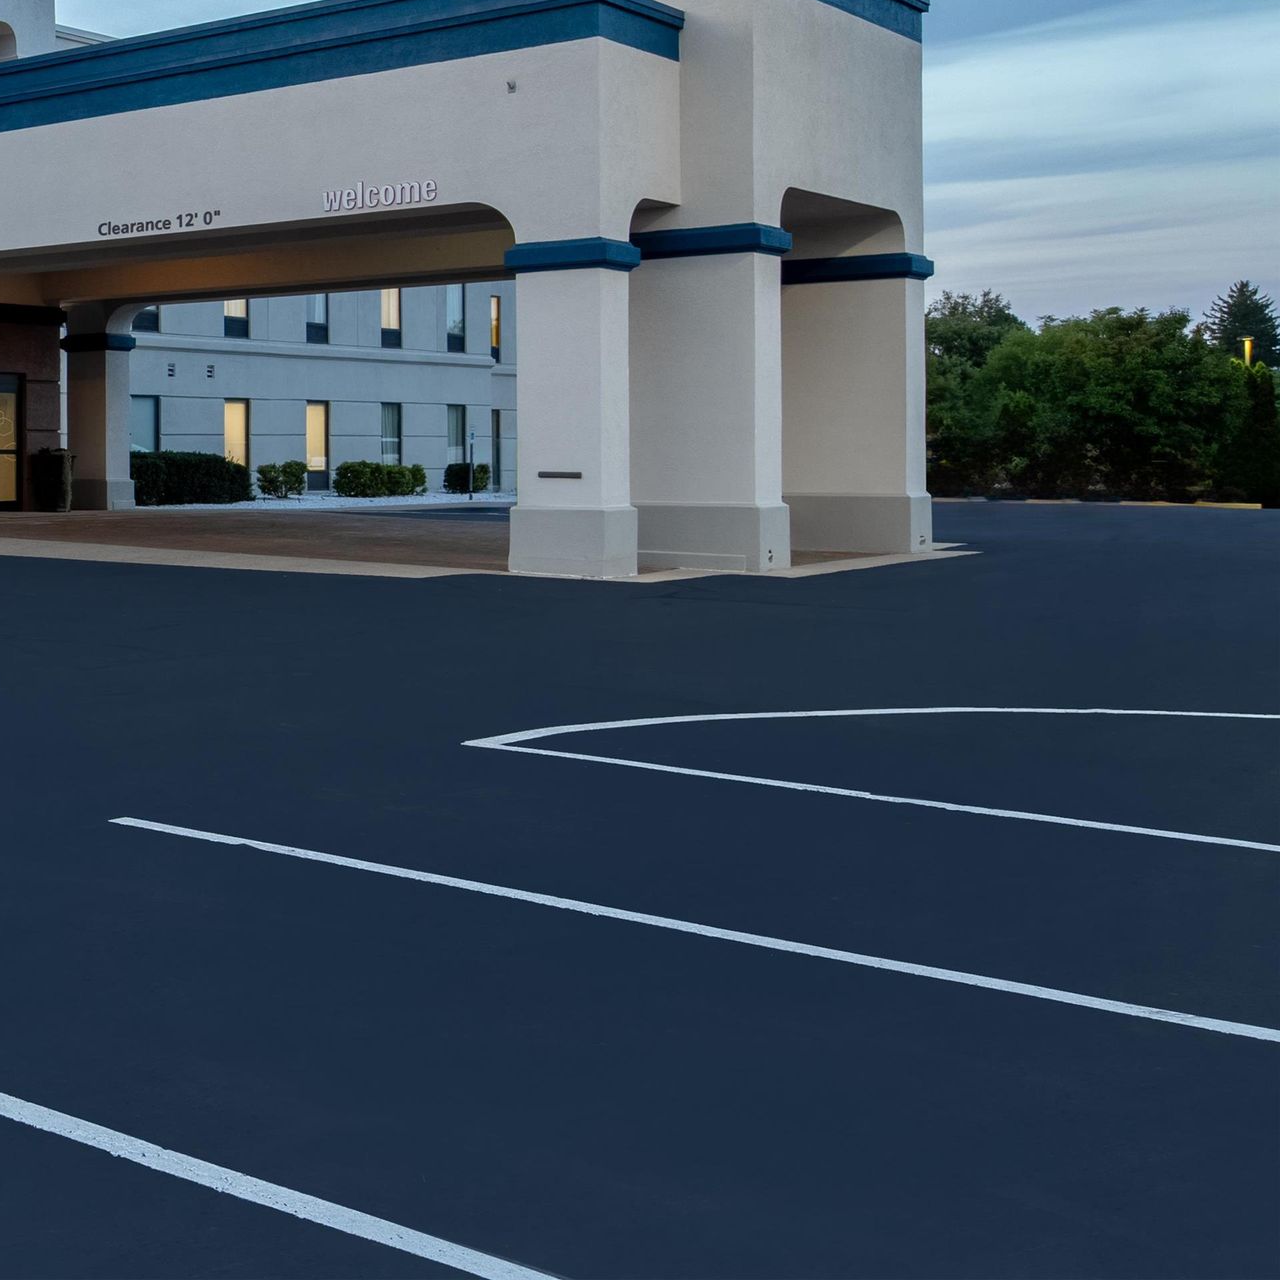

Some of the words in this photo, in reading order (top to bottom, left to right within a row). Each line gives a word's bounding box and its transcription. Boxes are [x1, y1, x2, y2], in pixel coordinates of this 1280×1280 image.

[321, 177, 439, 213] welcome
[97, 216, 172, 237] Clearance
[176, 212, 199, 228] 12'
